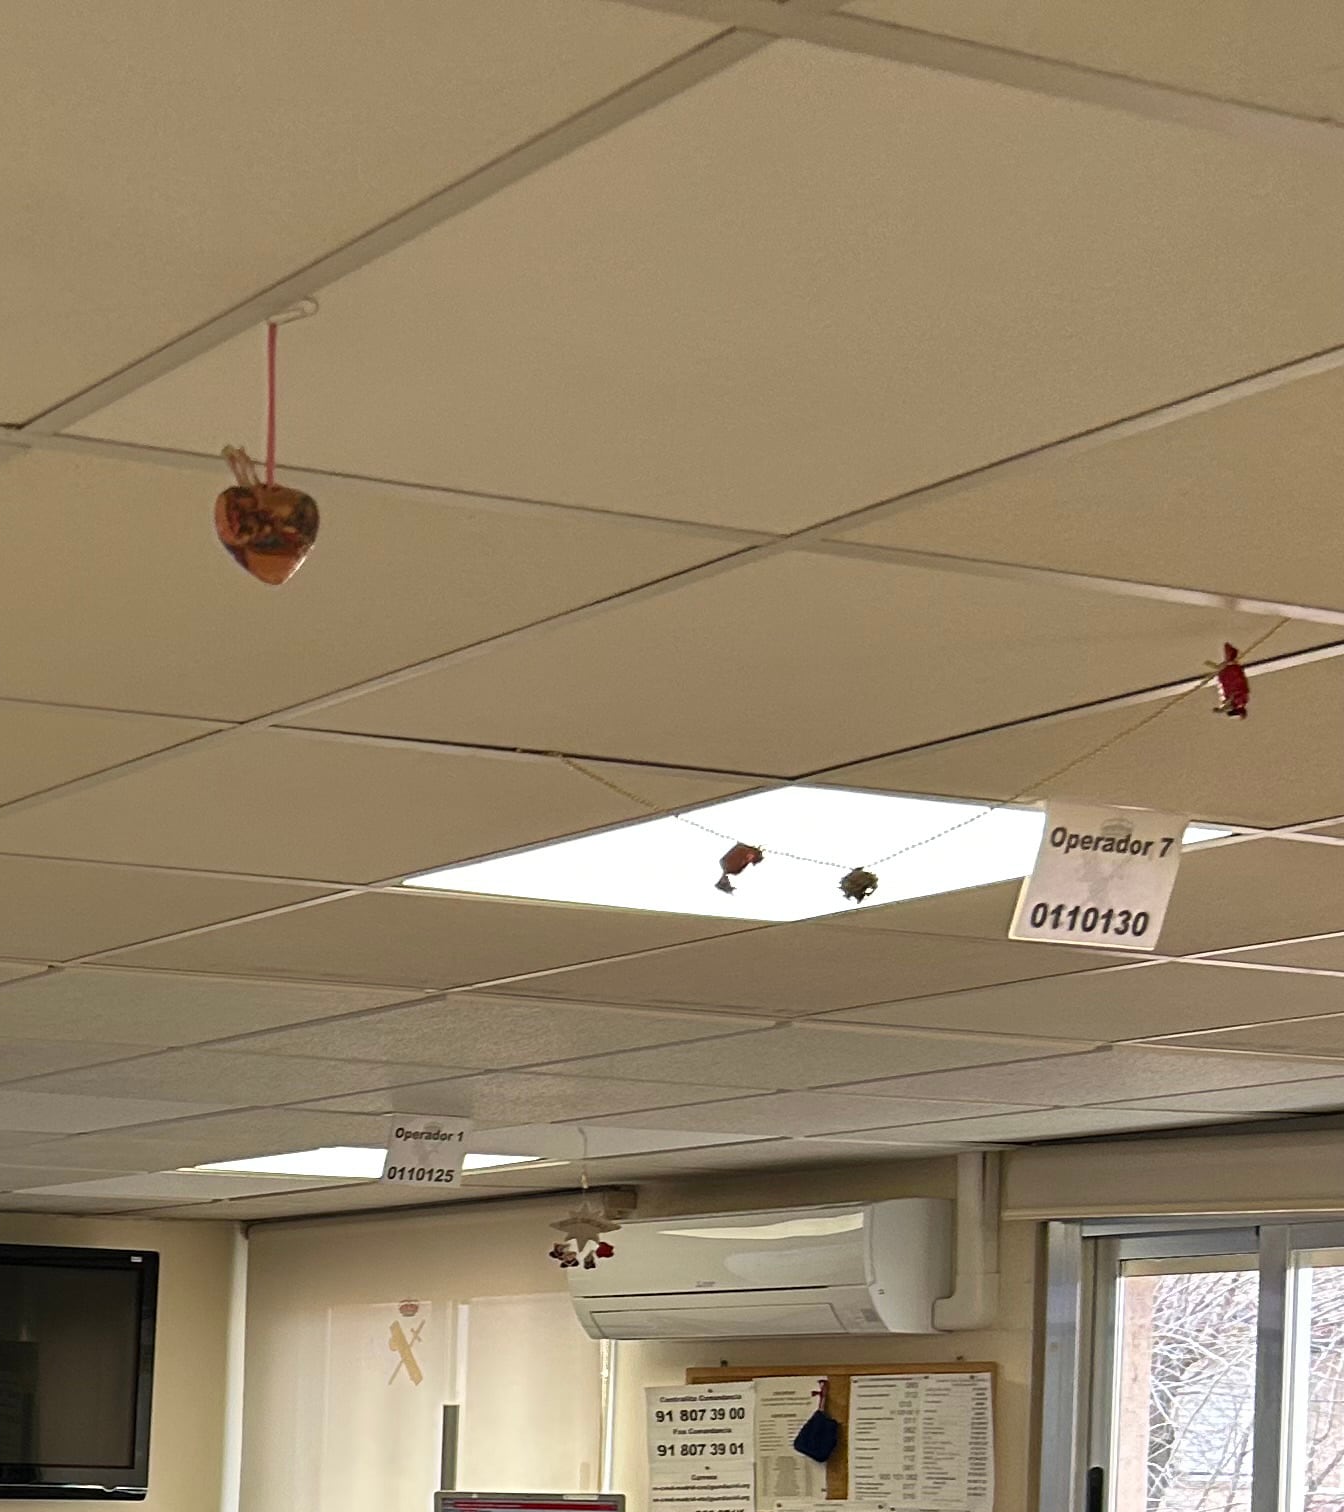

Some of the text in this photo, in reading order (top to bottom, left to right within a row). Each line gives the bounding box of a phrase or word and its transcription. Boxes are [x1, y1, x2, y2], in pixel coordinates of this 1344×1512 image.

[1050, 826, 1175, 858] Operador 7
[1030, 902, 1150, 937] 0110130
[395, 1127, 465, 1142] Operador 1
[387, 1166, 456, 1183] 0110125
[655, 1407, 745, 1423] 91 807 39 00
[657, 1443, 744, 1457] 91 807 39 01
